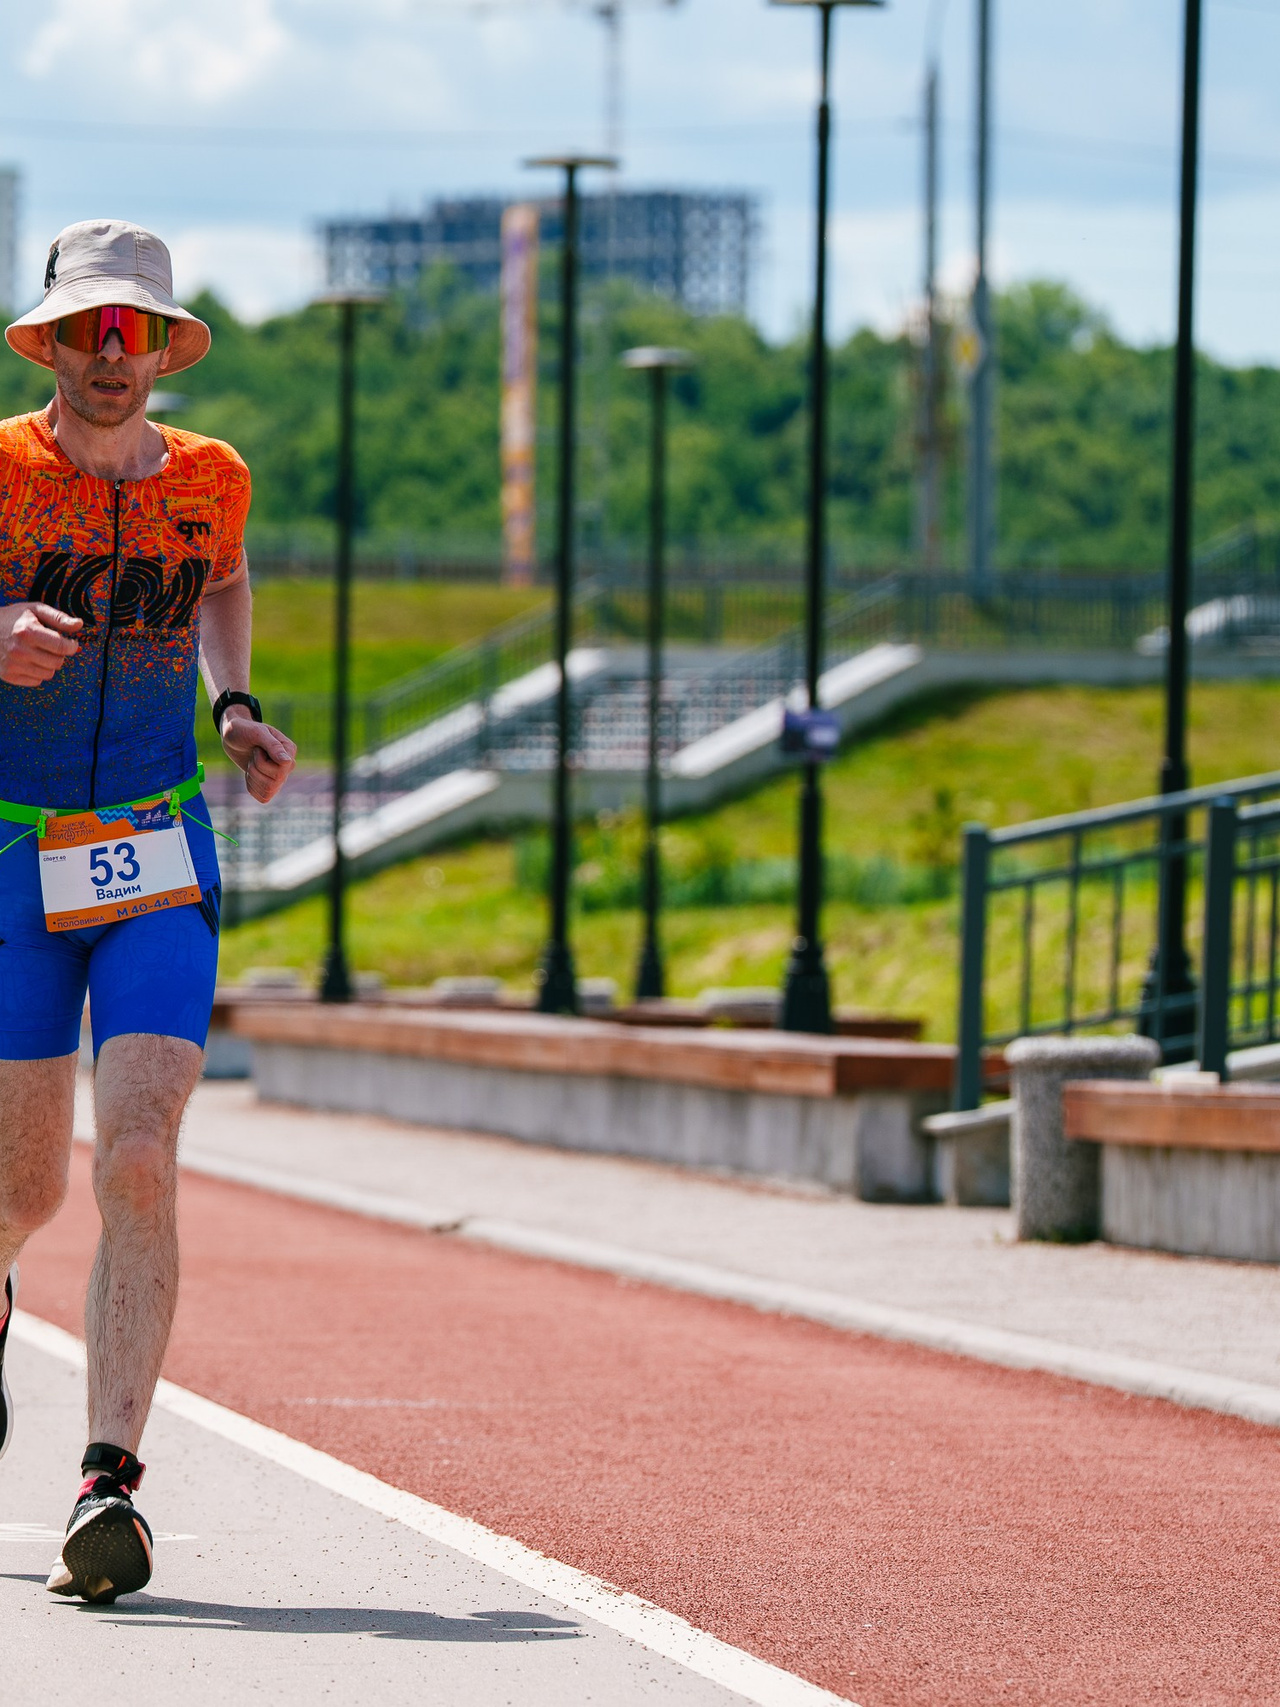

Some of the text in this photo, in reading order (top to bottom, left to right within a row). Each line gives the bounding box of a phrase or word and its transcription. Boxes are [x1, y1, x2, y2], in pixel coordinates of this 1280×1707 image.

[89, 842, 141, 887] 53
[96, 884, 142, 900] Вадим
[116, 897, 171, 919] М 40-44
[57, 915, 106, 929] ПОЛОВИНКА
